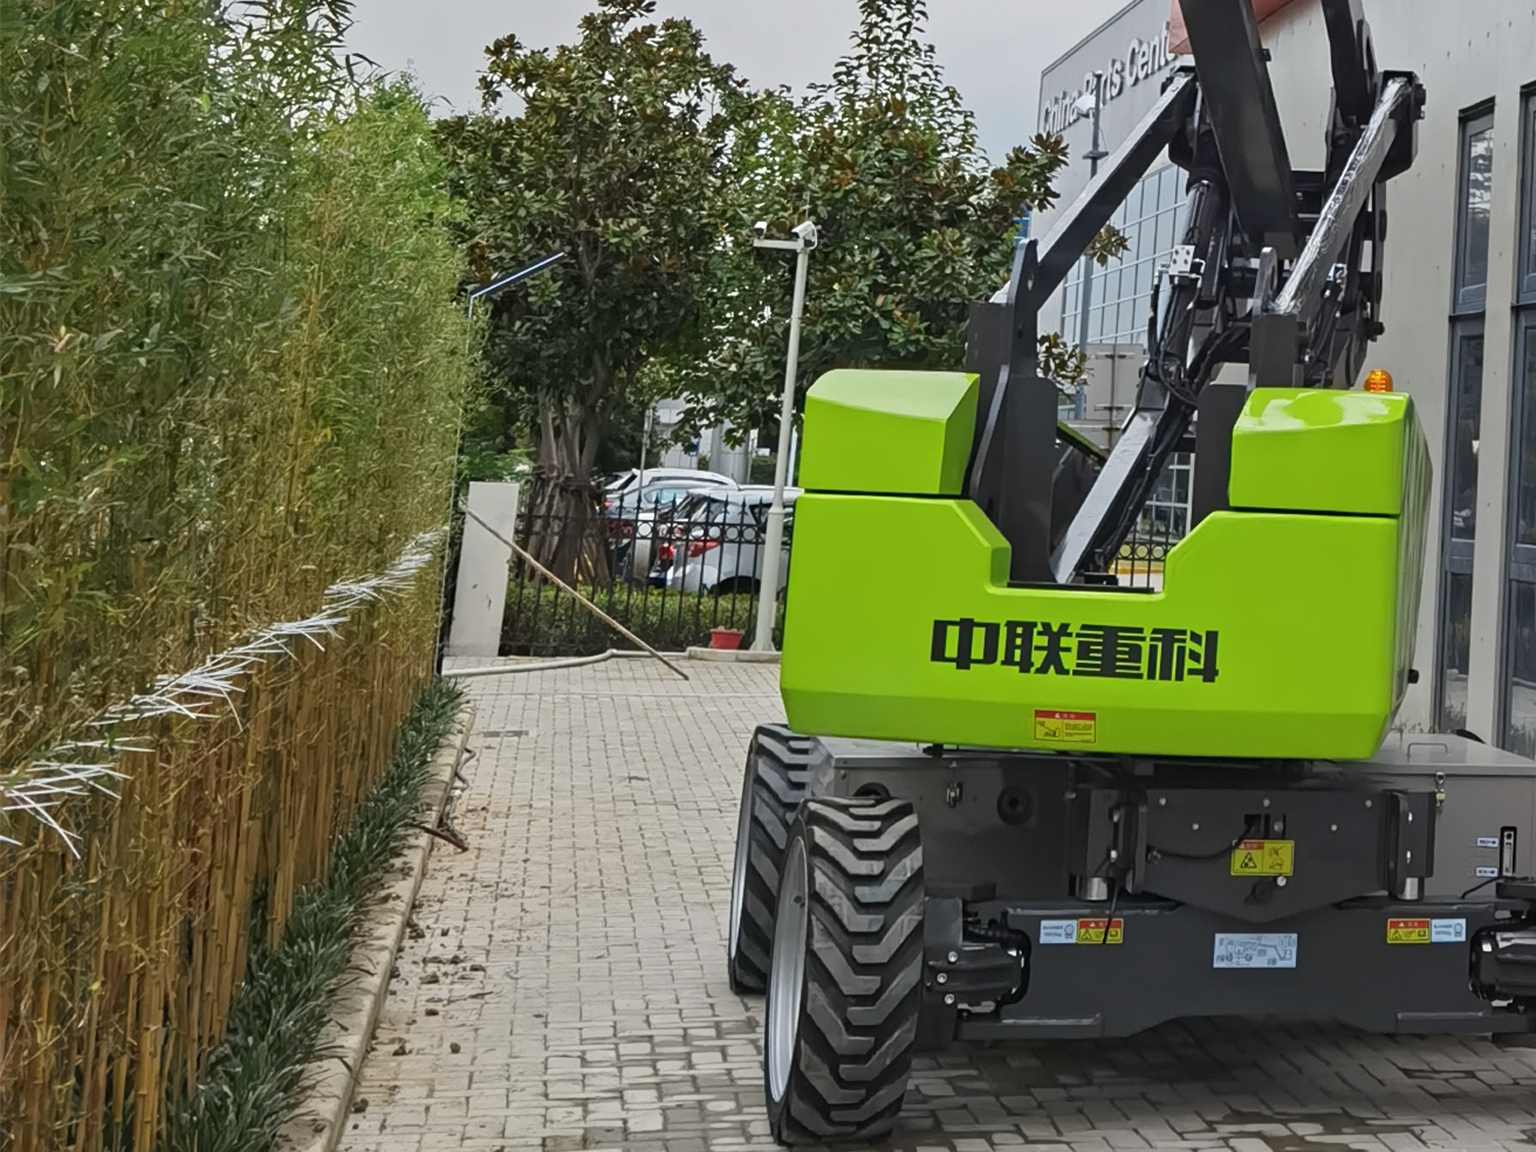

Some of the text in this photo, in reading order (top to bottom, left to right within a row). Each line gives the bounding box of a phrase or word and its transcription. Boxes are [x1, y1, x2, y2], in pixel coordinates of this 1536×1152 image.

[1084, 58, 1124, 111] Prts
[930, 617, 1219, 683] 中联重科
